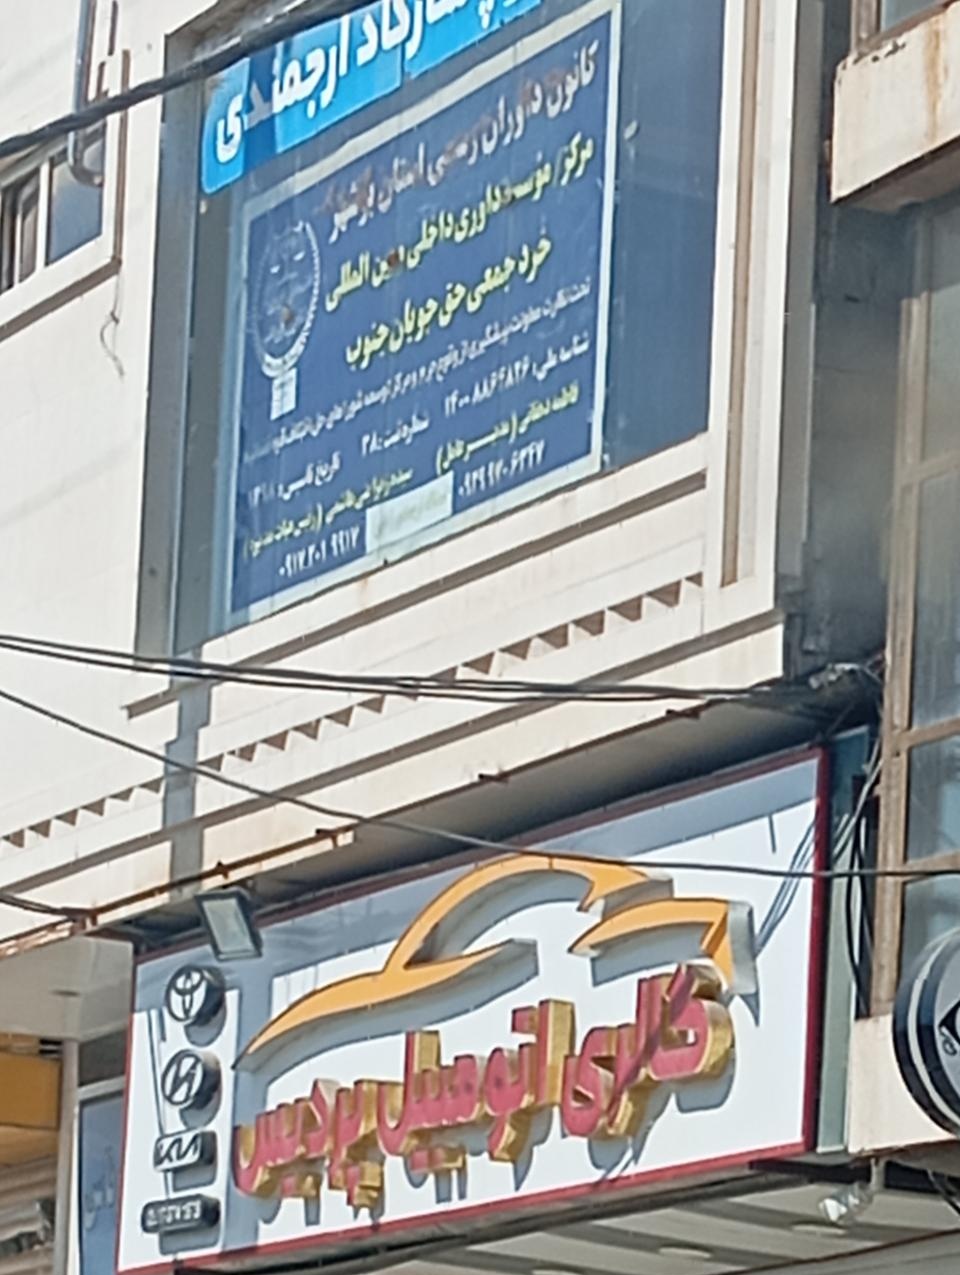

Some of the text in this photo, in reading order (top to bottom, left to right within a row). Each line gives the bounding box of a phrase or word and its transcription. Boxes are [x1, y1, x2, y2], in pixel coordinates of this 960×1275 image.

[216, 0, 496, 163] پسرگاد ارجمندی
[345, 321, 390, 371] جنوب
[436, 282, 466, 327] حق
[231, 1078, 384, 1208] پردیس
[376, 998, 574, 1168] اتومبیل
